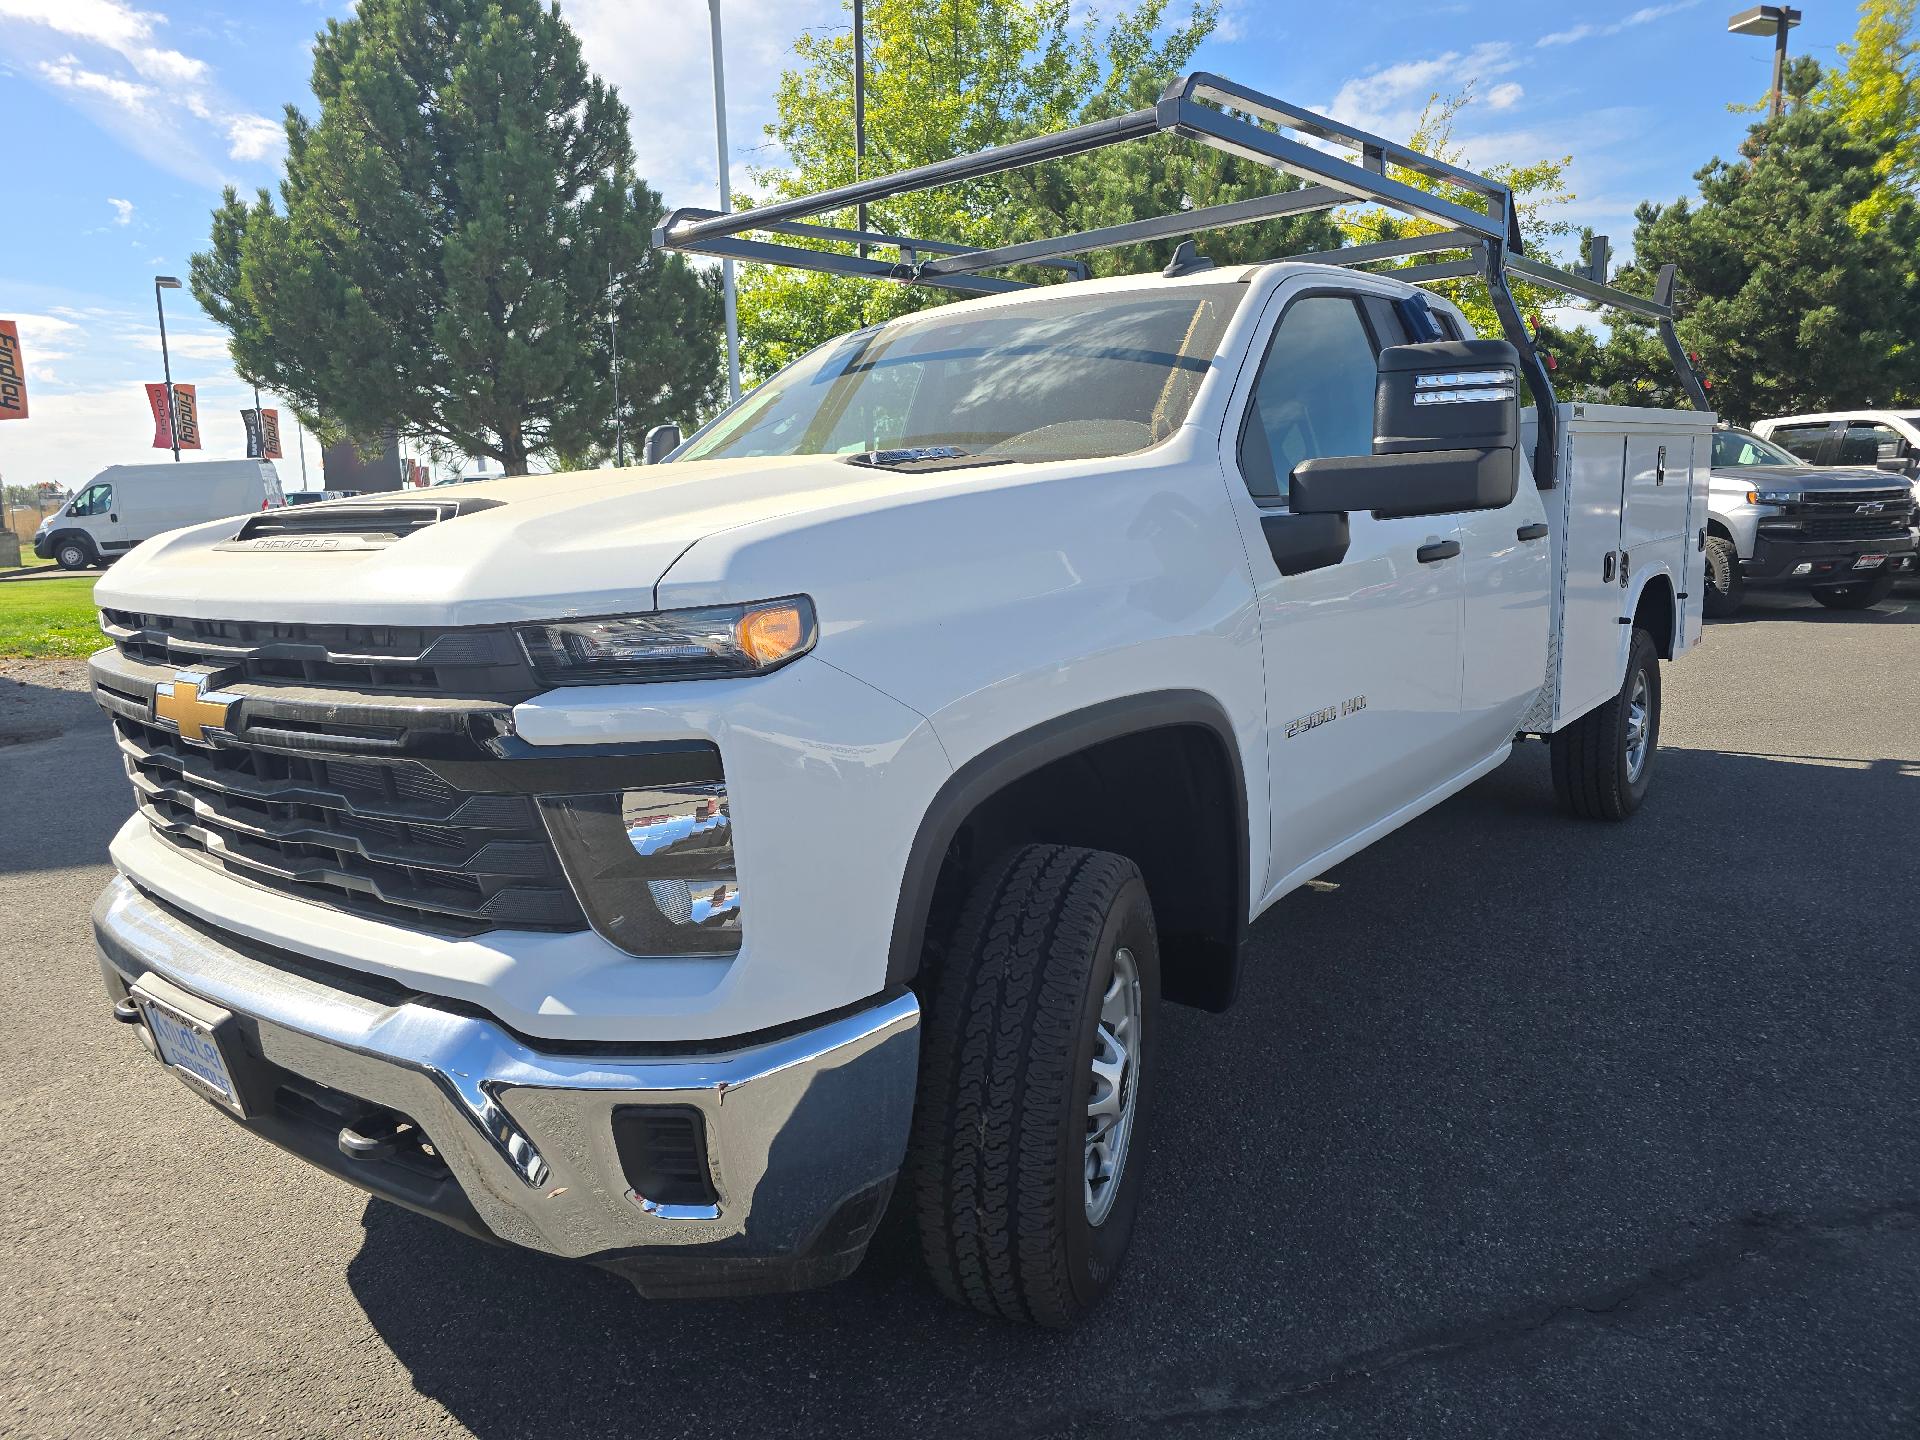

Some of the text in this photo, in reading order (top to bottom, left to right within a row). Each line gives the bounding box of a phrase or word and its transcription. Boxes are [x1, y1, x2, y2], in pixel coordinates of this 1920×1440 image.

[154, 389, 167, 436] DODGE
[179, 391, 197, 444] Findlay
[250, 425, 258, 456] RAM
[264, 414, 280, 455] Findlay
[254, 539, 340, 549] CHEVROLET
[1285, 694, 1368, 739] 2500 HD
